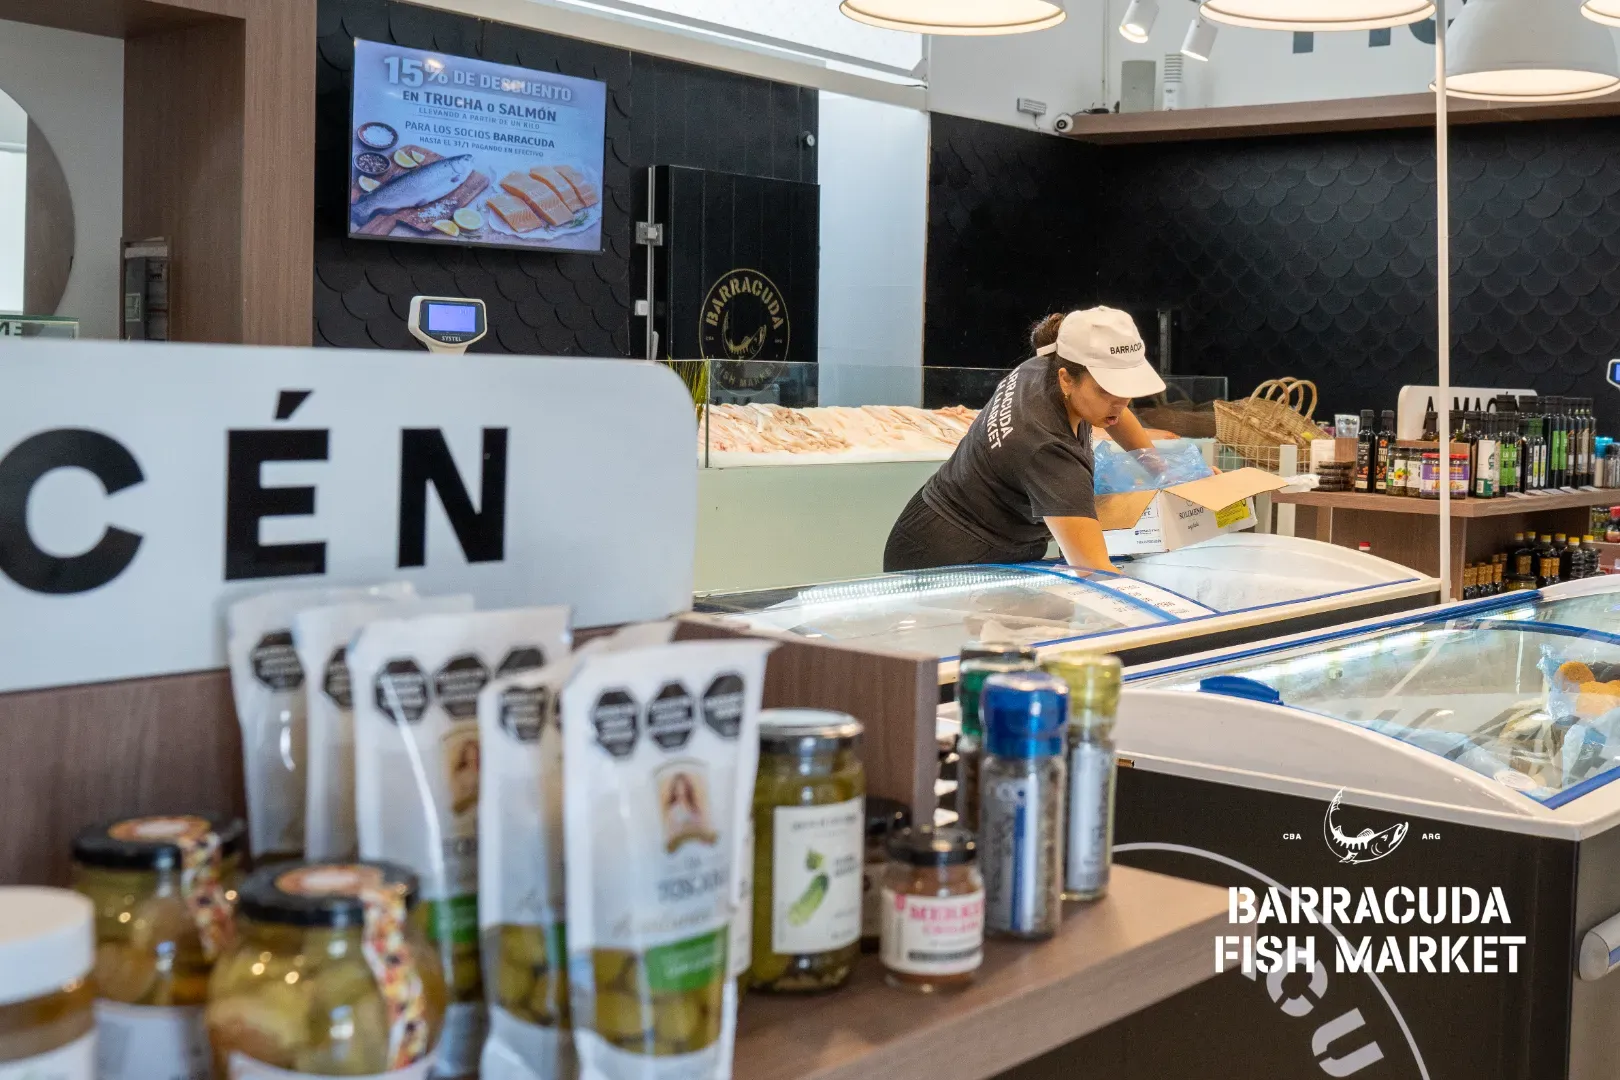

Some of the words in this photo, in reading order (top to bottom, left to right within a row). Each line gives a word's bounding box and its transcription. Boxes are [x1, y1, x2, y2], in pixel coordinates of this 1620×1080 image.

[384, 56, 448, 88] 15%
[453, 70, 476, 87] DE
[480, 73, 572, 101] DESCUENTO
[402, 90, 419, 103] EN
[424, 92, 483, 111] TRUCHA
[499, 103, 557, 122] SALMÓN
[418, 107, 460, 119] LLEVANDO
[470, 114, 498, 124] PARTIR
[523, 122, 540, 130] KILO
[405, 120, 430, 132] PARA
[433, 124, 451, 135] LOS
[454, 127, 491, 140] SOCIOS
[493, 132, 555, 149] BARRACUDA
[419, 136, 442, 145] HASTA
[471, 142, 503, 153] PAGANDO
[514, 148, 544, 158] EFECTIVO
[705, 276, 784, 330] BARRACUDA
